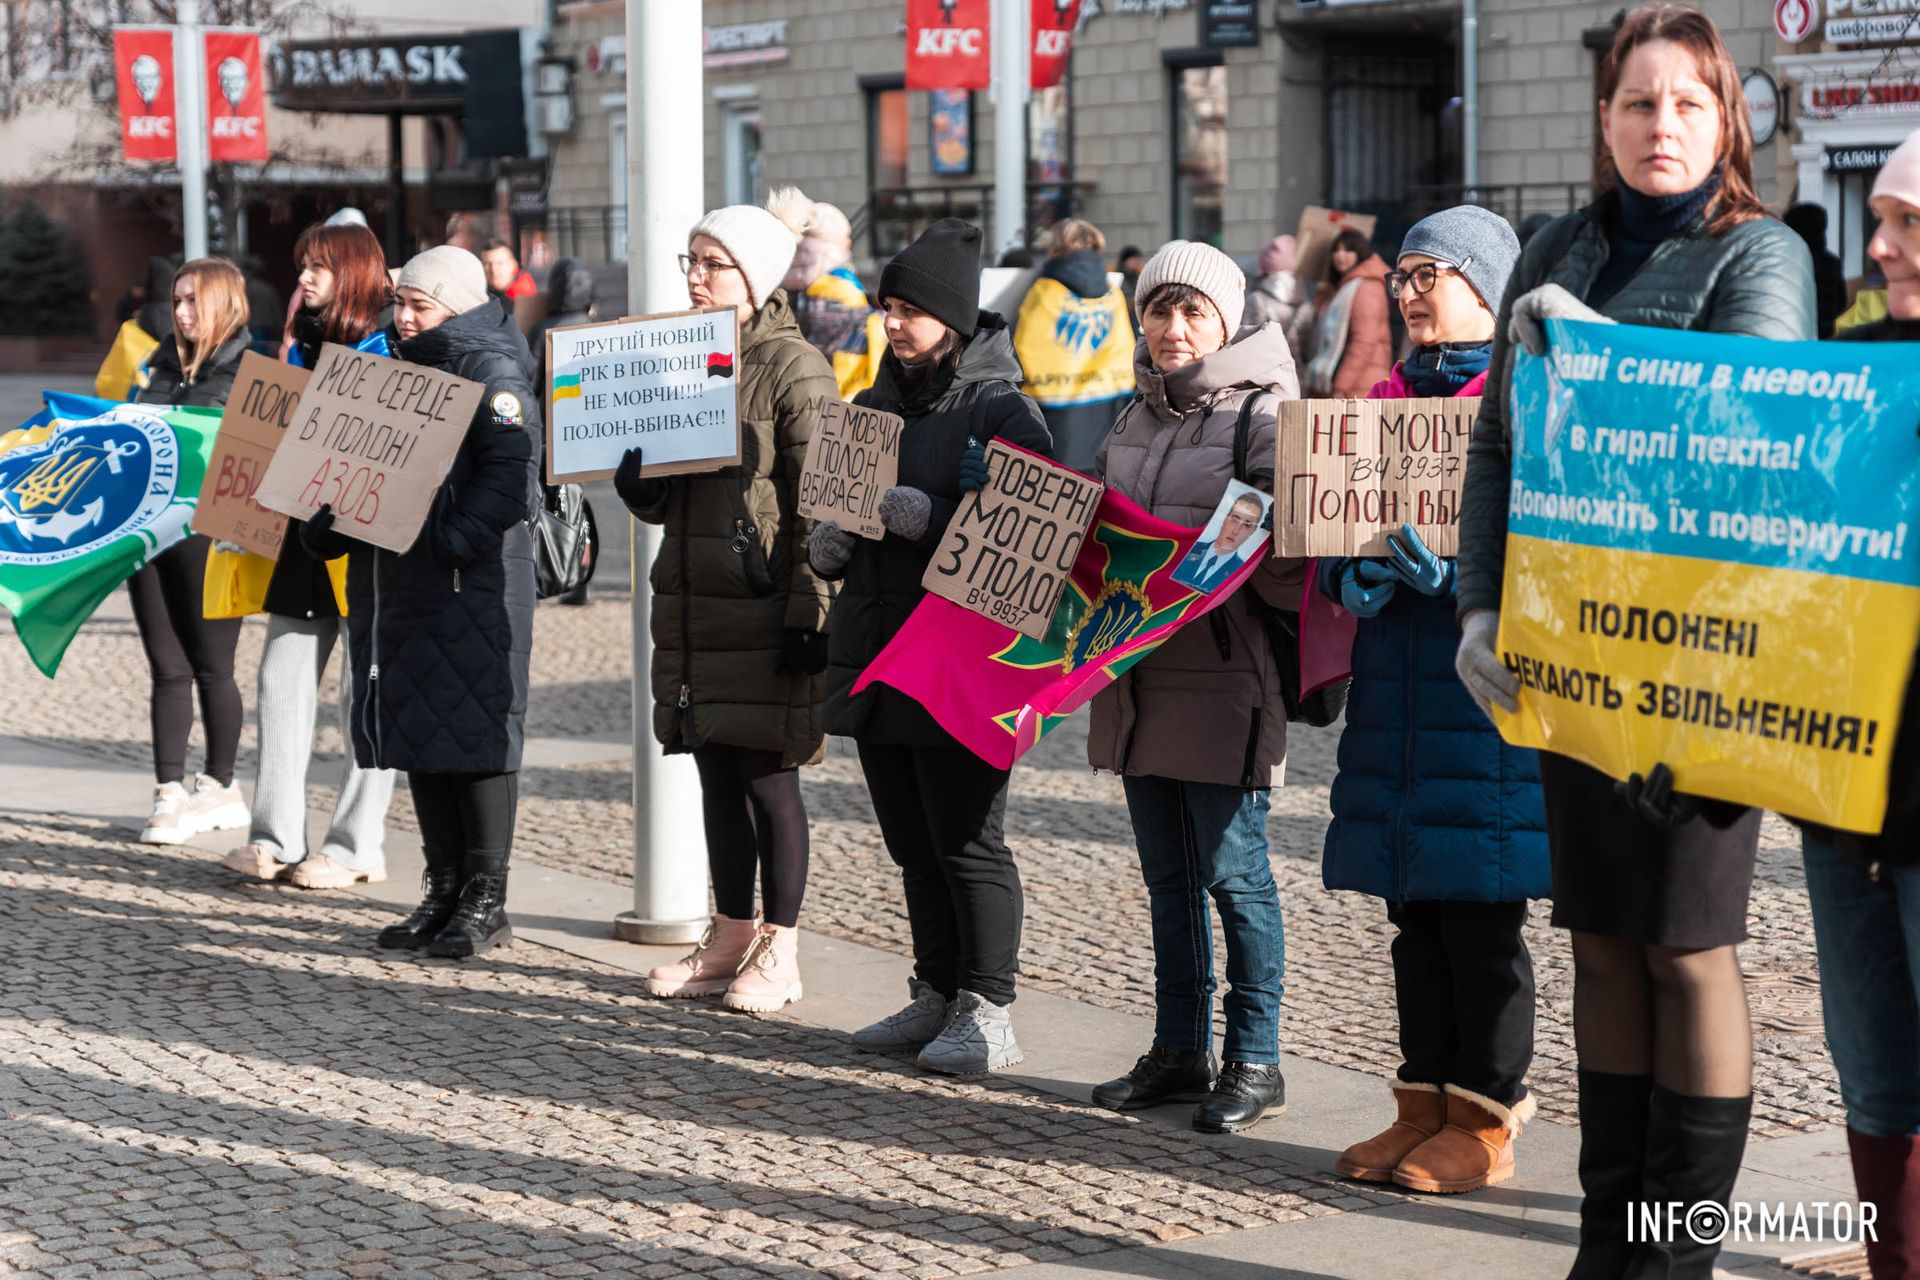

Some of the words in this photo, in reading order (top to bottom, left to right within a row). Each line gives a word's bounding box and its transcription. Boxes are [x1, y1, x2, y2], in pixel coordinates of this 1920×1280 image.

[915, 27, 982, 55] KFC
[128, 116, 172, 137] KFC
[212, 116, 261, 137] KFC
[1834, 151, 1877, 168] САЛОН
[573, 331, 645, 358] ДРУГИЙ
[651, 321, 715, 347] НОВИЙ
[316, 352, 376, 400] МОЄ
[377, 368, 461, 422] СЕРЦЕ
[581, 365, 608, 382] РІК
[614, 363, 625, 379] В
[1616, 356, 1703, 389] сини
[1710, 364, 1734, 390] в
[1739, 365, 1878, 412] неволі,
[584, 393, 608, 410] НЕ
[612, 383, 703, 407] МОВЧИ!!!!
[299, 406, 321, 441] В
[322, 411, 426, 469] ПОЛОНІ
[563, 409, 725, 441] ПОЛОН-ВБИВАЄ!!!
[840, 407, 900, 457] МОВЧИ
[1313, 413, 1359, 456] НЕ
[1570, 424, 1587, 452] в
[1594, 423, 1680, 466] гирлі
[1686, 433, 1806, 471] пекла!
[816, 437, 879, 483] ПОЛОН
[1395, 455, 1460, 481] 9937
[297, 457, 386, 525] АЗОВ
[800, 472, 879, 519] ВБИВАЄ!!!
[959, 493, 1058, 562] МОГО
[1509, 478, 1658, 533] Допоможіть
[1667, 497, 1700, 536] їх
[1708, 509, 1908, 562] повернути!
[937, 532, 970, 576] З
[966, 588, 991, 612] ВЧ
[990, 599, 1030, 627] 9937
[1579, 599, 1758, 658] ПОЛОНЕНІ
[1503, 651, 1624, 711] ЧЕКАЮТЬ
[1637, 680, 1878, 757] ЗВІЛЬНЕННЯ!
